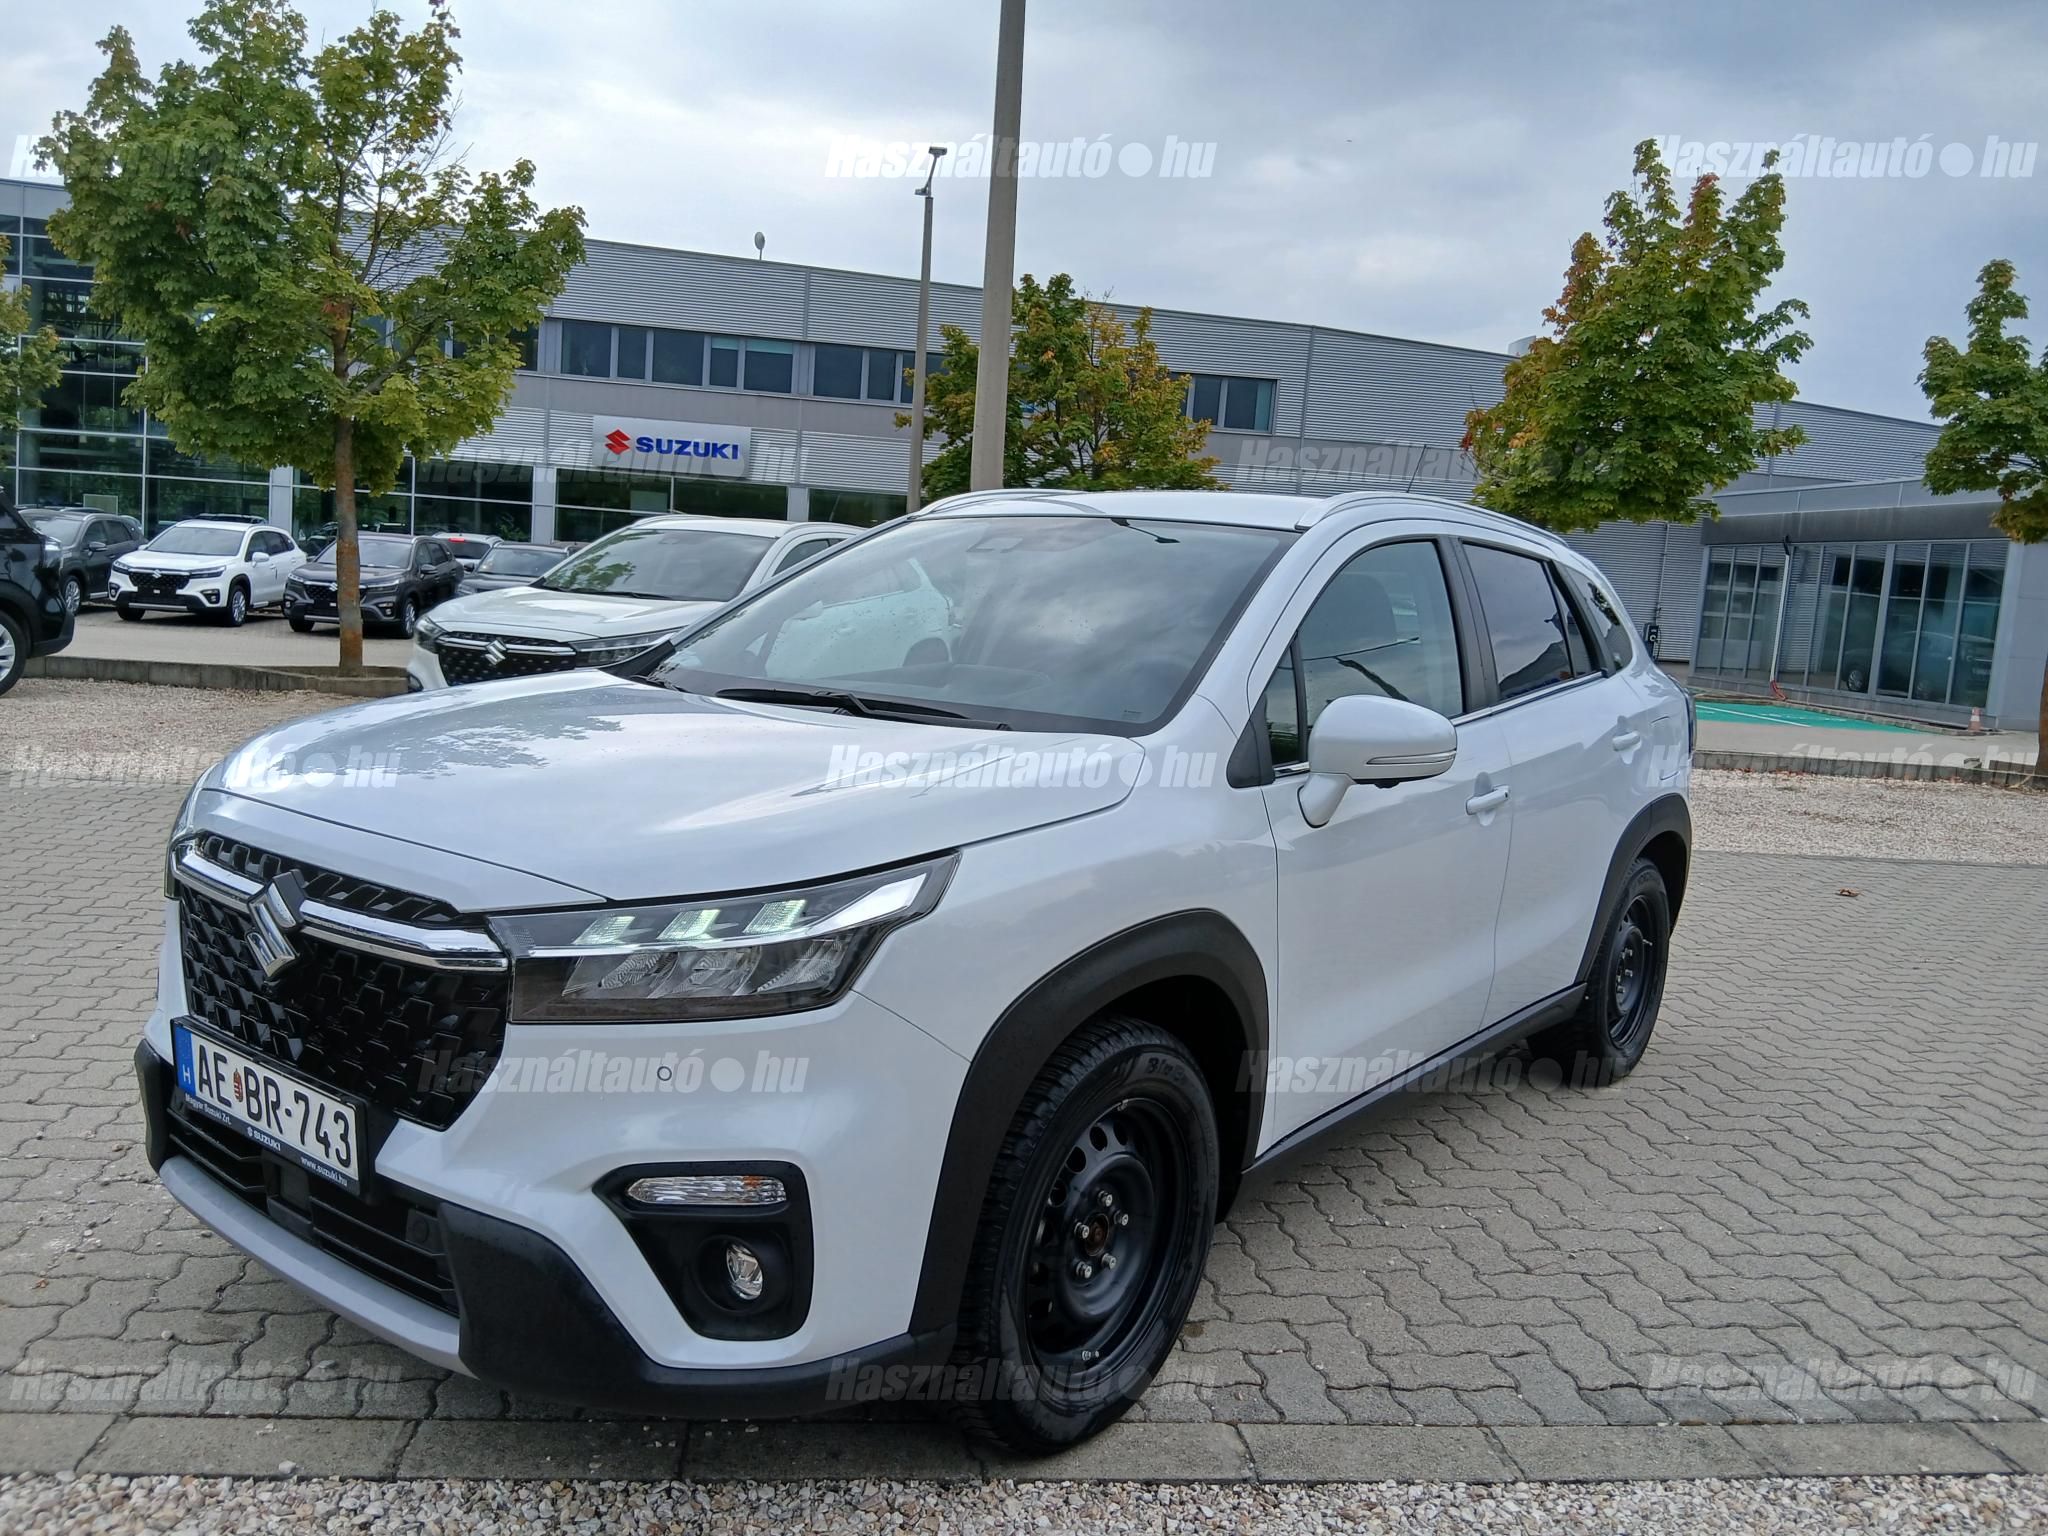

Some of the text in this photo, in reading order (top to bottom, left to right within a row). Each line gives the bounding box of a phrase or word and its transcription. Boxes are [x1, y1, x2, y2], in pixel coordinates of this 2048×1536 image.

[636, 436, 739, 460] SUZUKI
[204, 1103, 222, 1120] Suzuki
[253, 1129, 281, 1152] SUZUKI
[300, 1156, 348, 1187] www.suzuki.hu
